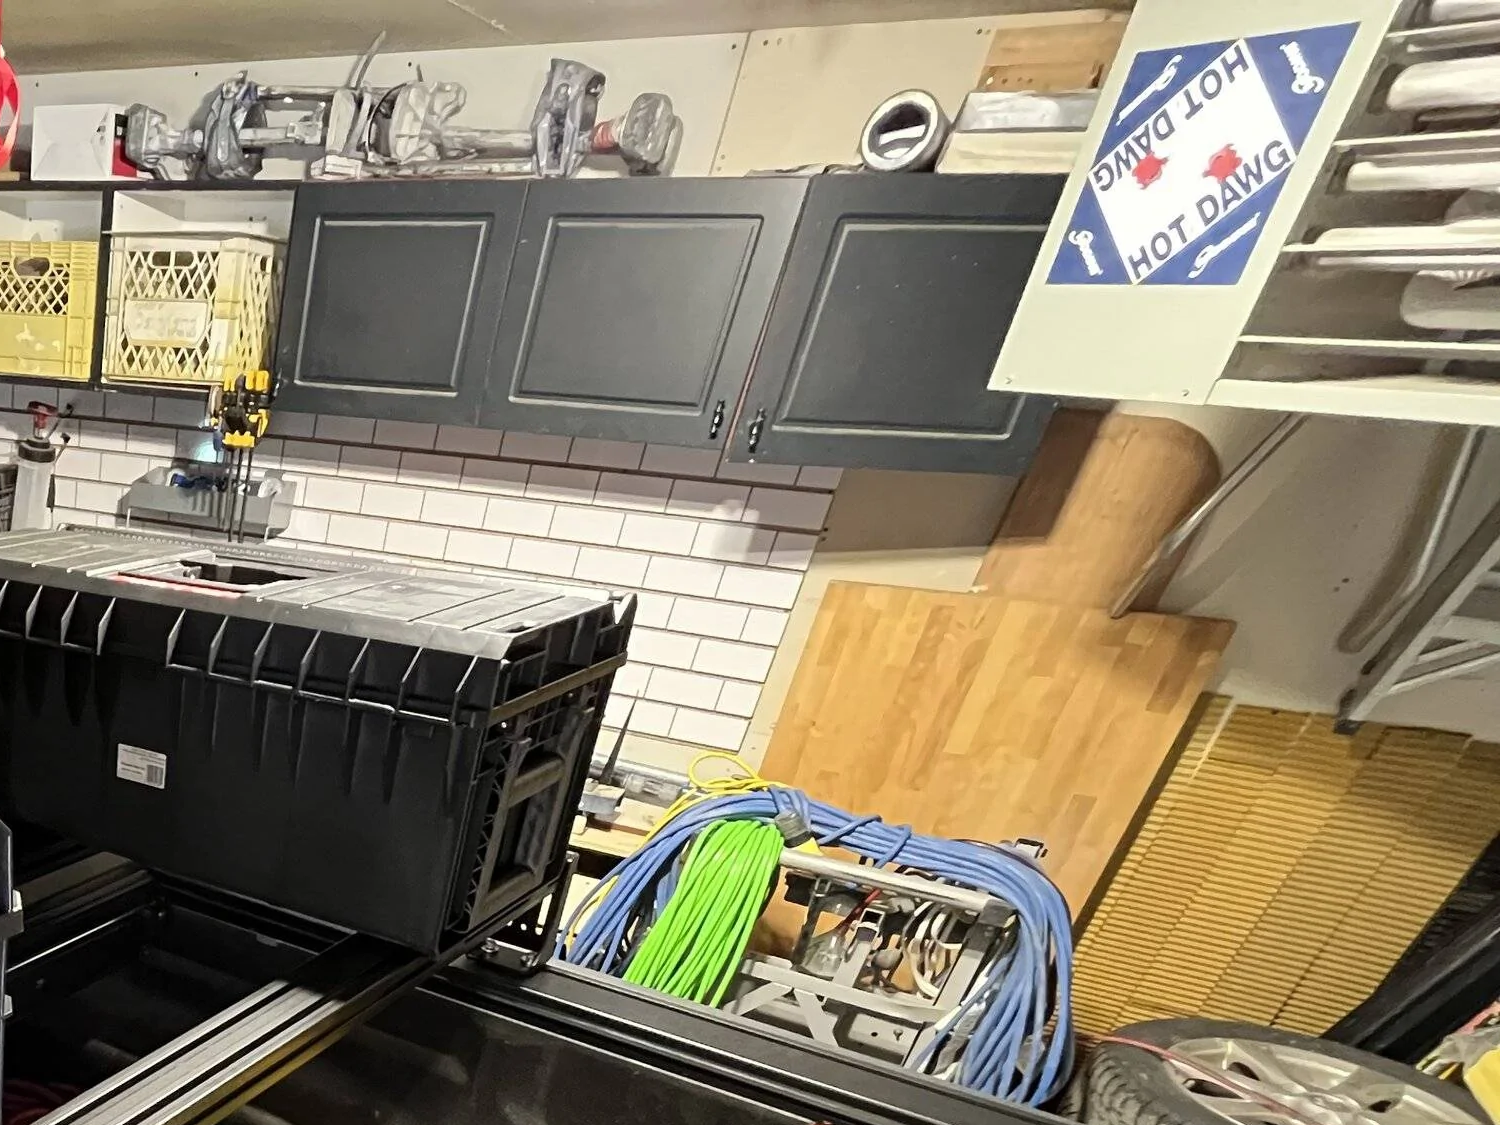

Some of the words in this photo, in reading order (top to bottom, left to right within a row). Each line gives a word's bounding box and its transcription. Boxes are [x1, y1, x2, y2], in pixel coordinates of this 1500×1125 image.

[1184, 45, 1249, 120] HOT
[1094, 108, 1176, 192] DAWG
[1128, 214, 1188, 280] HOT
[1195, 140, 1291, 227] DAWG
